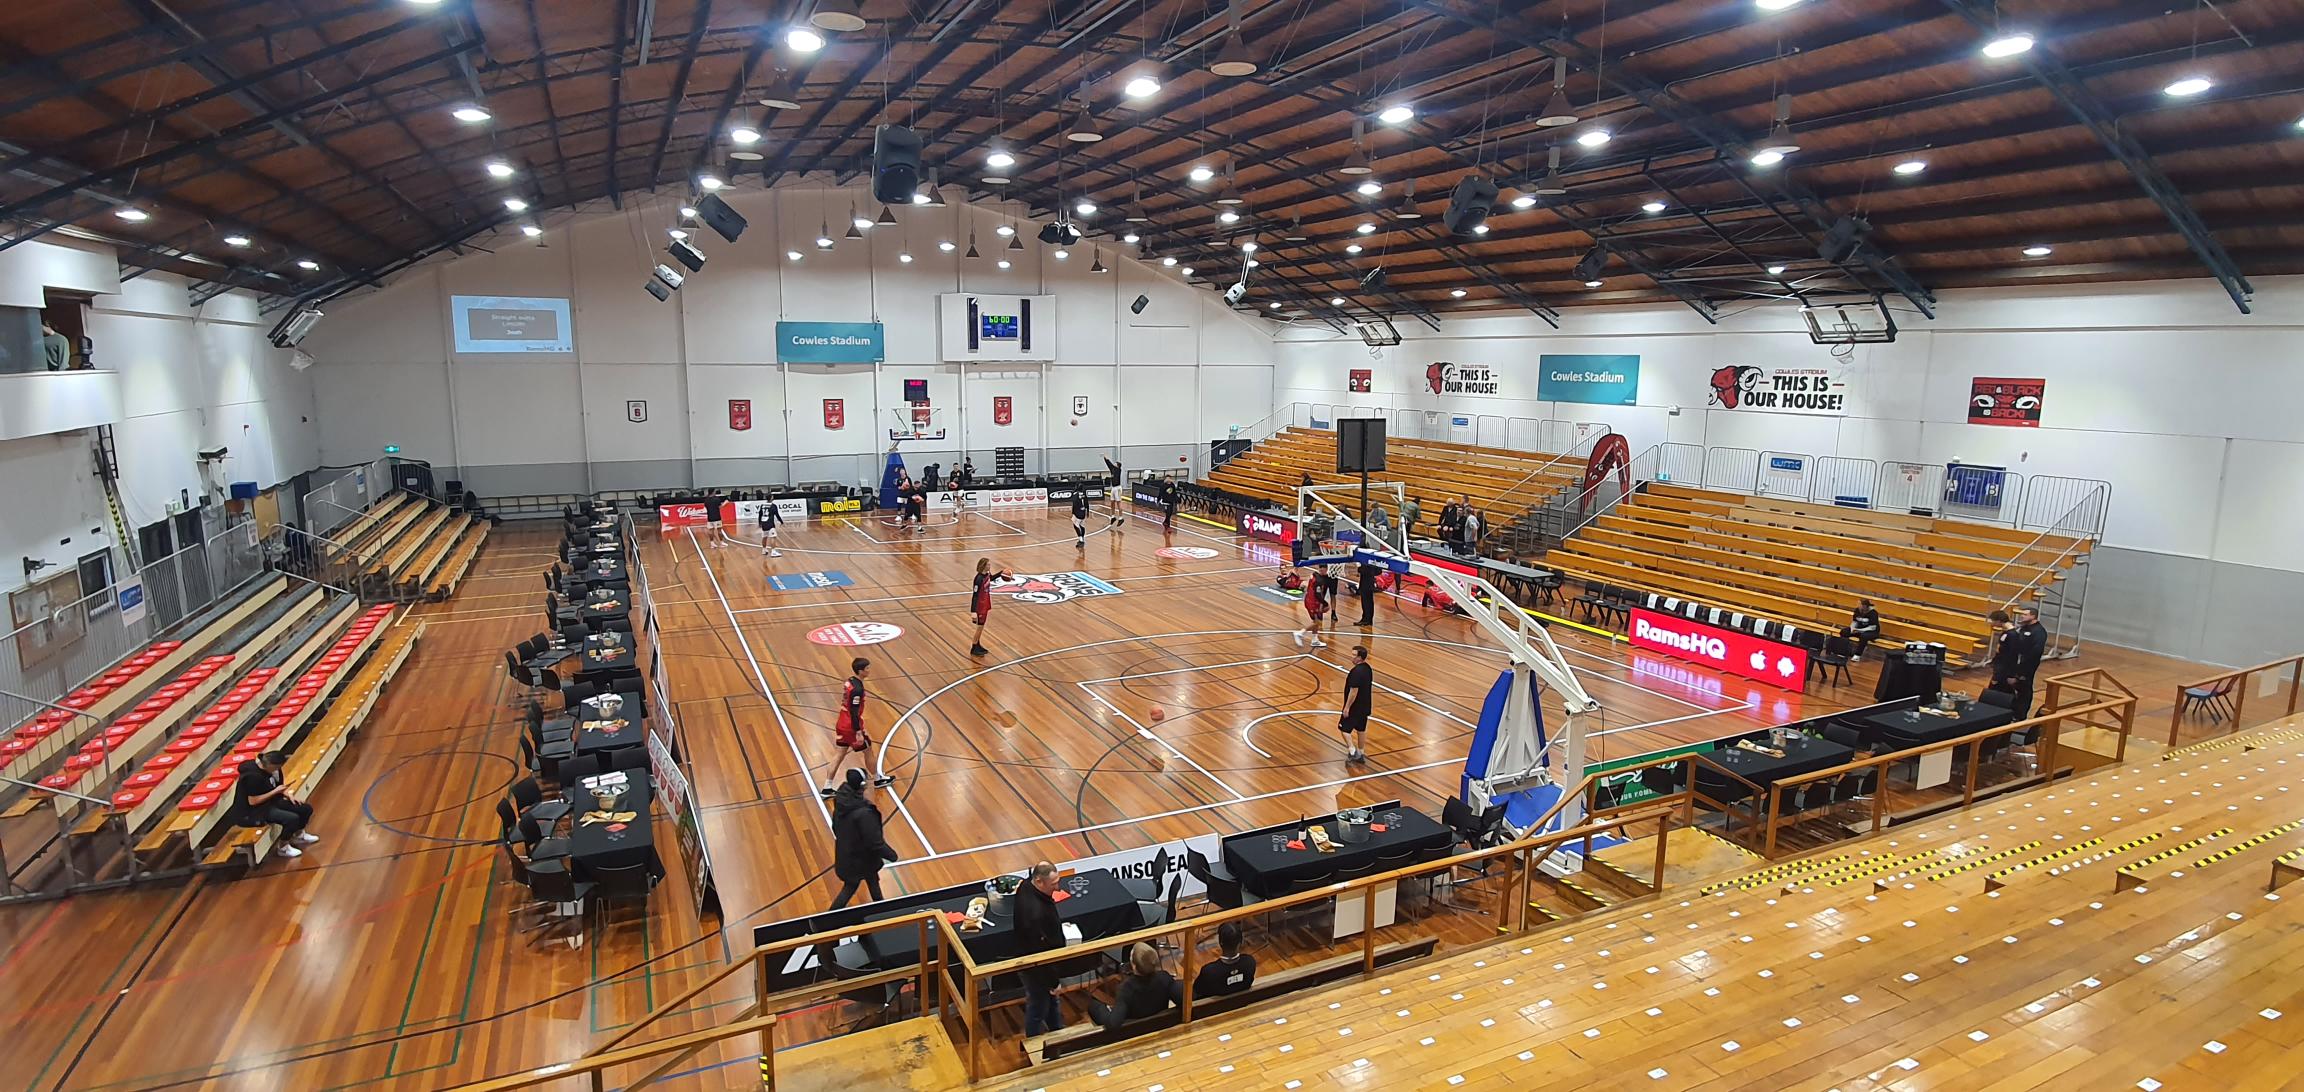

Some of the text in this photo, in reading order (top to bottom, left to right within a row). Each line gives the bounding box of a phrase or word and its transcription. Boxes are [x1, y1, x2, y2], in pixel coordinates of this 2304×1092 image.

[792, 335, 871, 346] Cowles Stadium
[1460, 369, 1490, 381] THIS IS
[1551, 371, 1624, 383] Cowles Stadium
[1444, 381, 1498, 395] OUR HOUSE!
[1772, 375, 1829, 392] THIS IS
[2002, 385, 2042, 396] BLACK
[1744, 391, 1844, 411] OUR HOUSE!
[1635, 618, 1726, 661] RamsHQ
